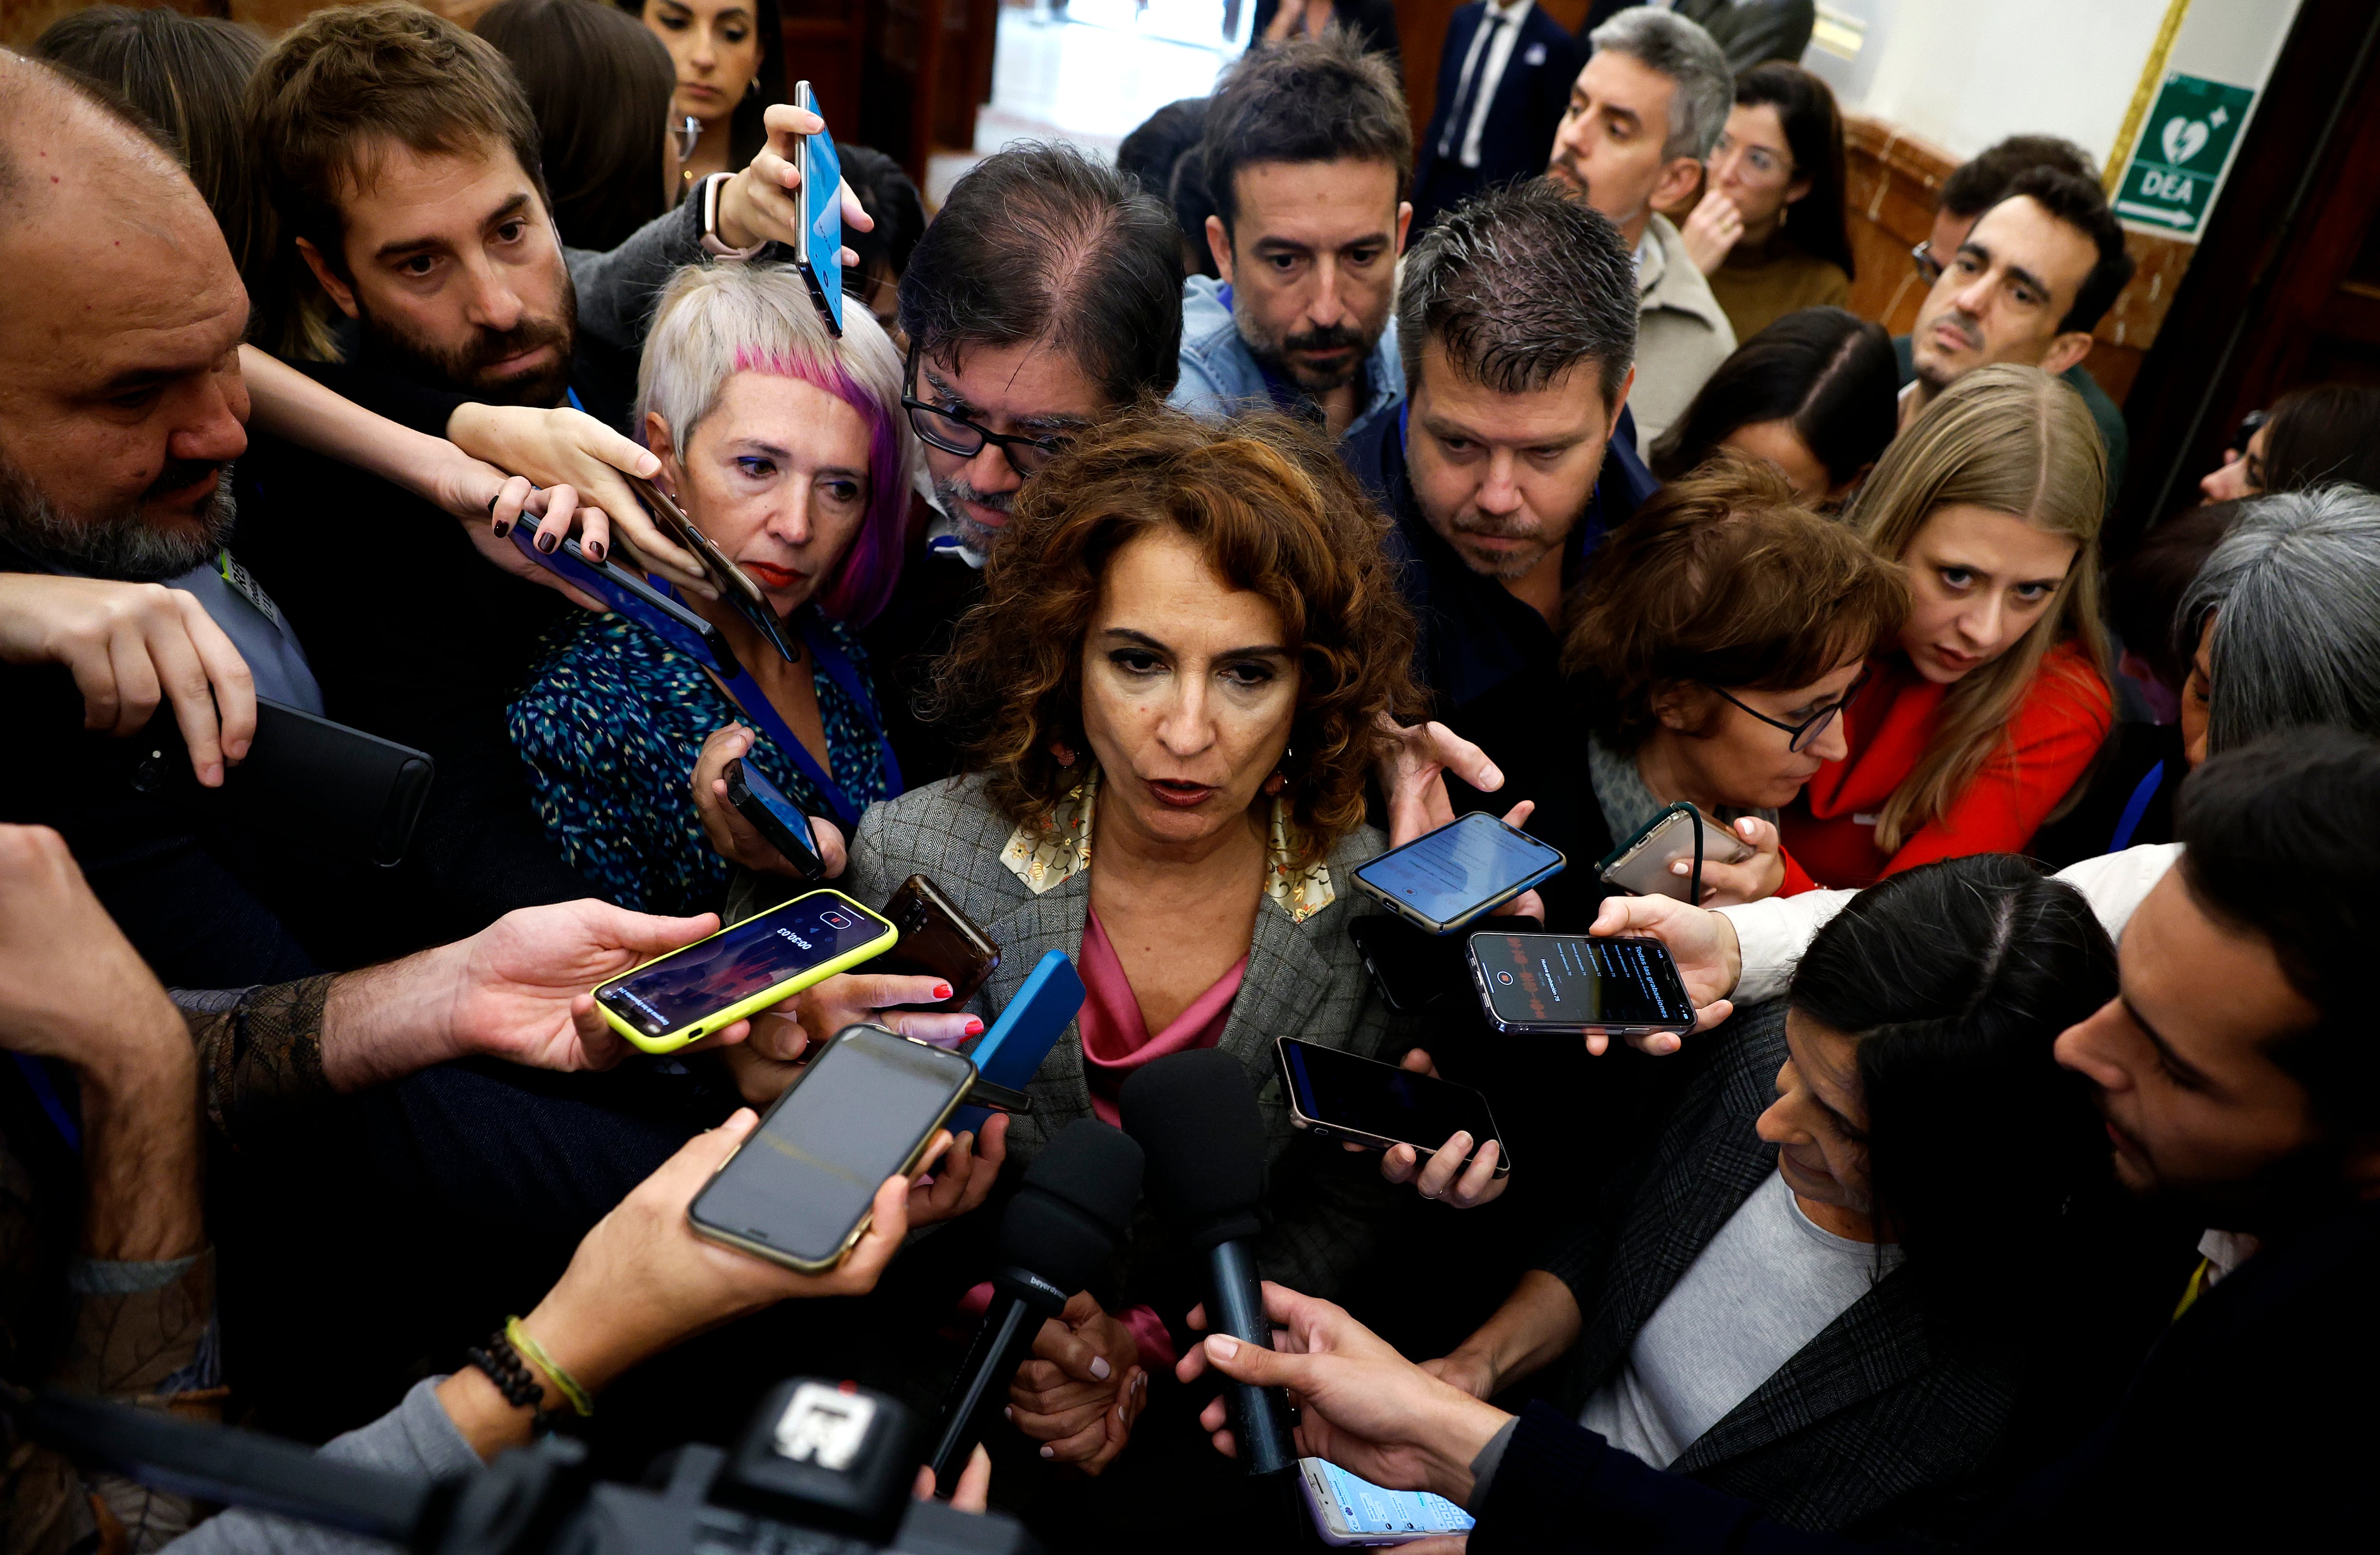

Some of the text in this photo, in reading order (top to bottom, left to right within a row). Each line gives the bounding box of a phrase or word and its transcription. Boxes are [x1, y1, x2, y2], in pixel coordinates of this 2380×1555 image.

[2140, 171, 2193, 205] DEA
[777, 928, 812, 950] 00:30,03
[1560, 954, 1570, 971] grabación
[1575, 954, 1585, 971] grabación
[1589, 955, 1599, 972] grabación
[1604, 955, 1614, 972] grabación
[1618, 956, 1628, 973] grabación
[1540, 958, 1549, 973] Nueva
[1545, 973, 1557, 995] grabación
[1635, 946, 1646, 965] Todas
[1646, 977, 1668, 1018] grabaciones
